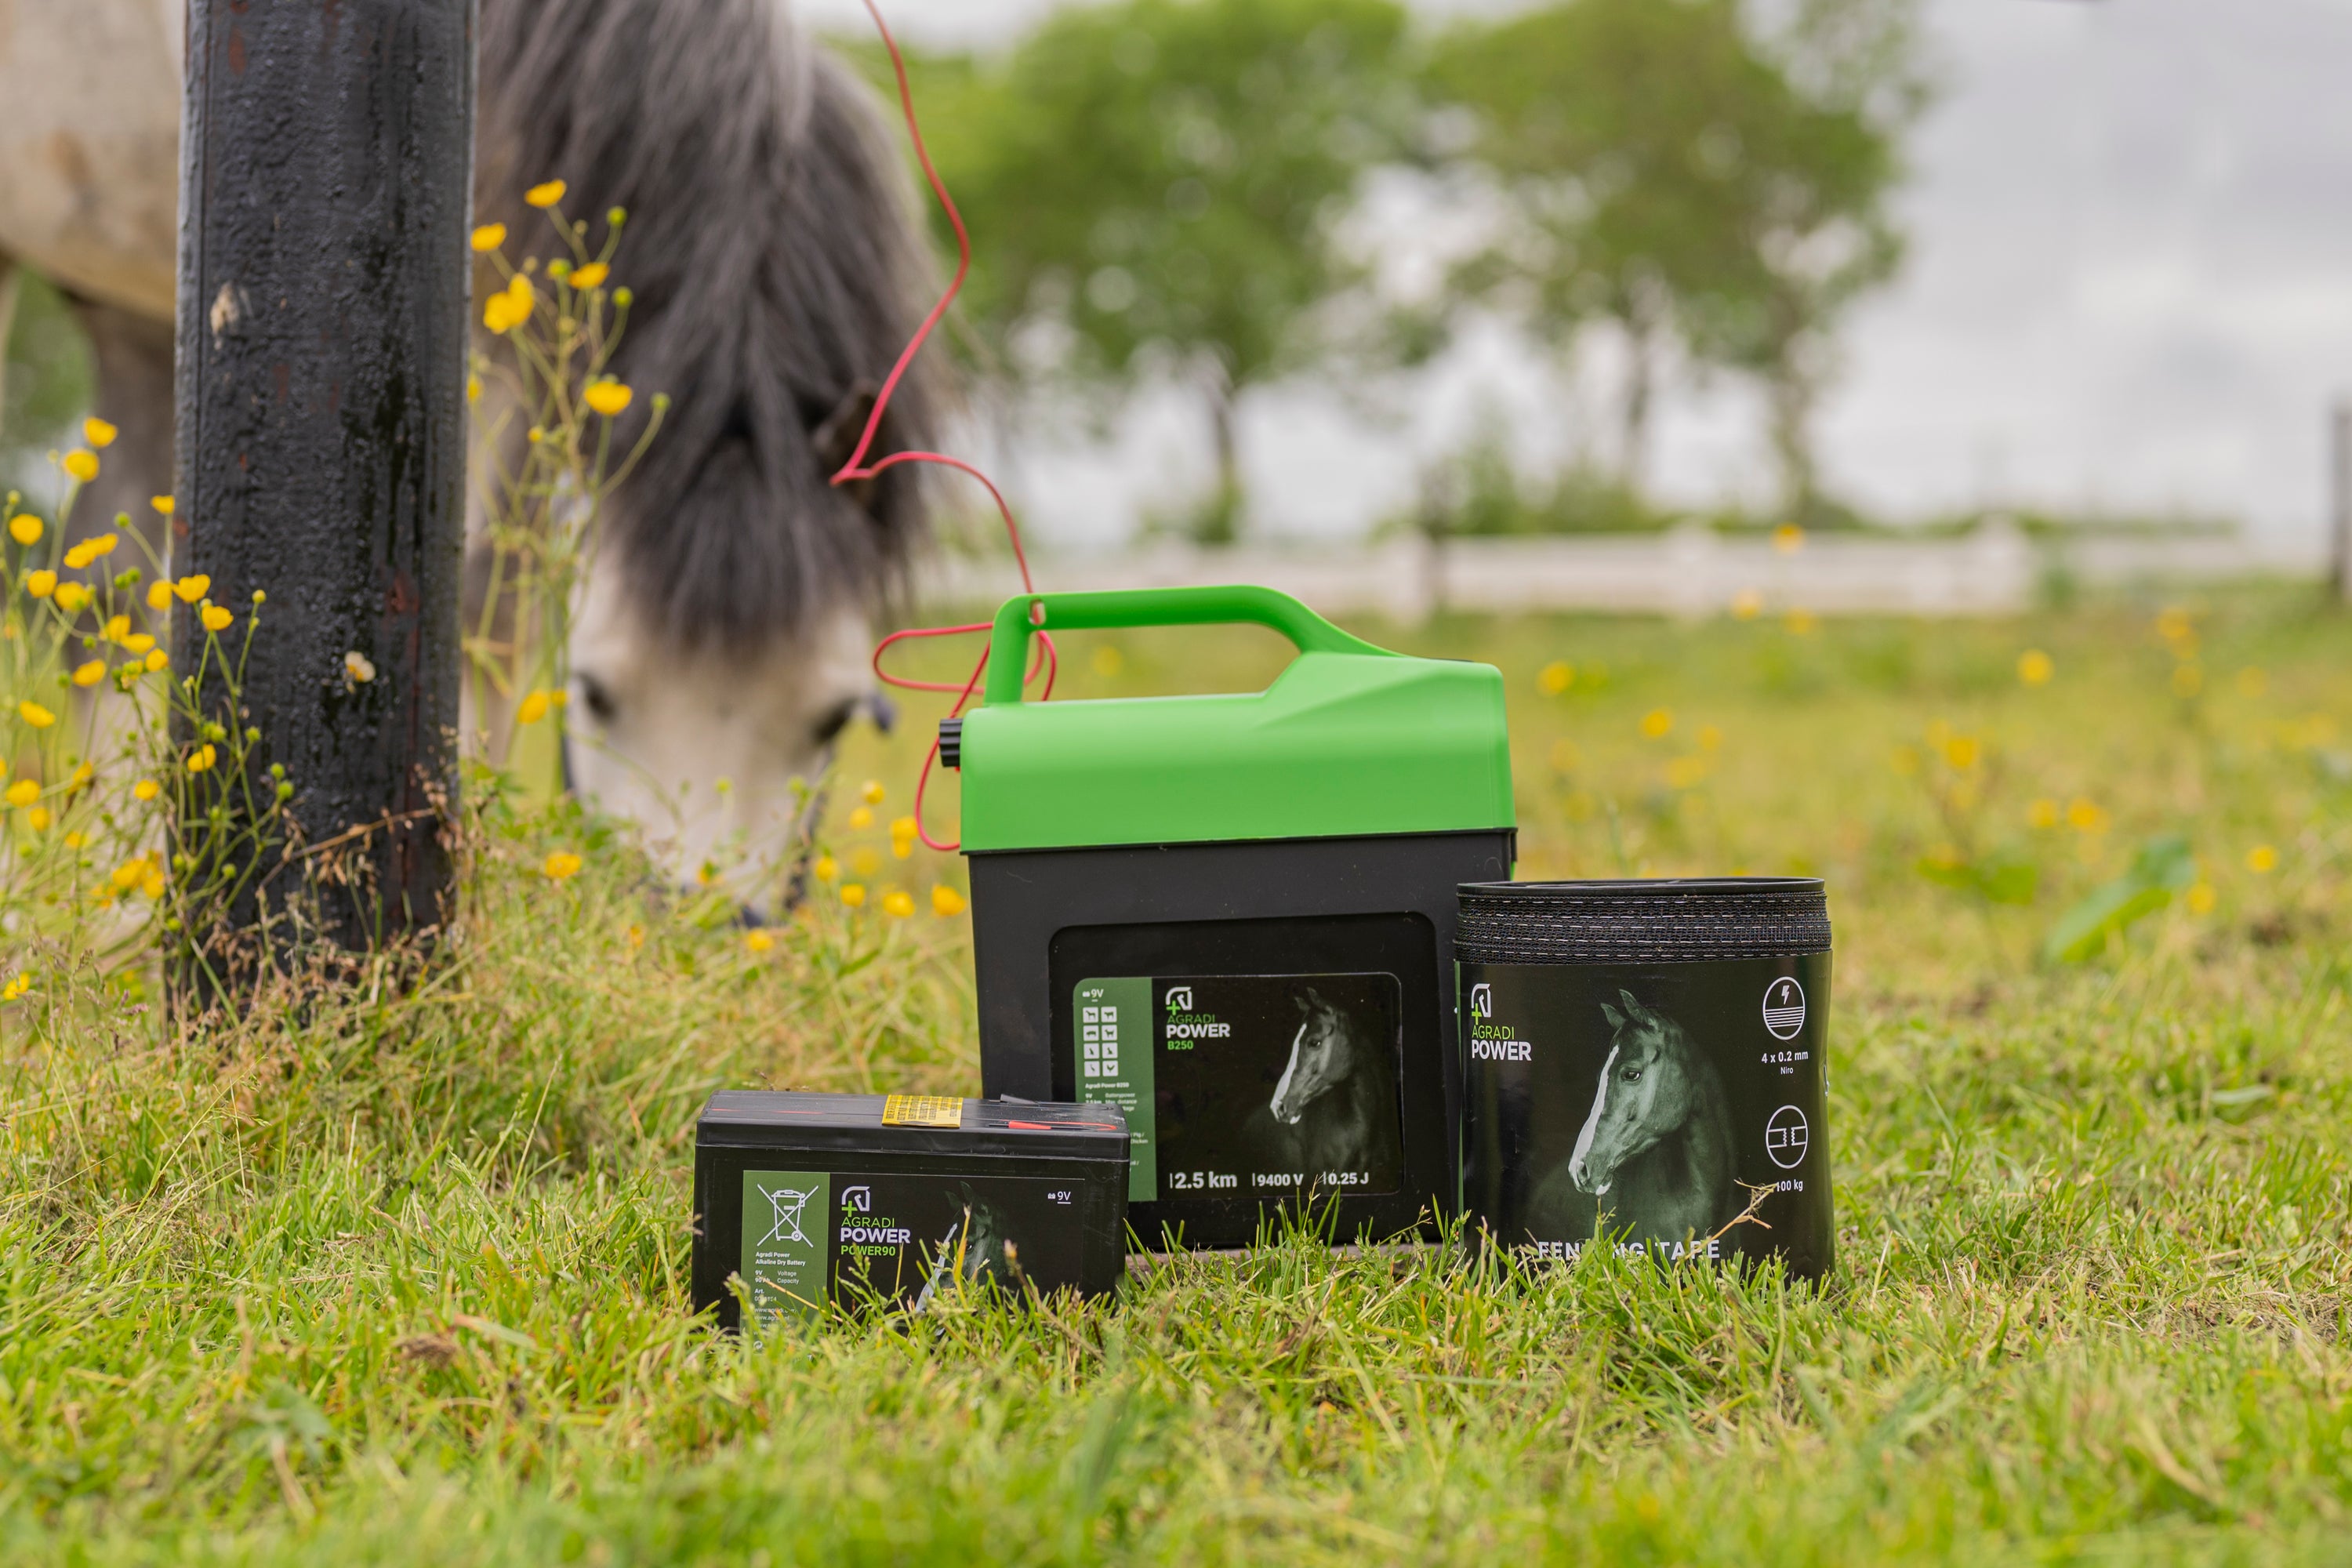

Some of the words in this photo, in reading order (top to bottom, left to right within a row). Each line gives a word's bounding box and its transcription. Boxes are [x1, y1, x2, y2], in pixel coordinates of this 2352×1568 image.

[1091, 988, 1105, 998] 9V
[1167, 1014, 1215, 1024] AGRADI
[1166, 1023, 1231, 1039] POWER
[1472, 1025, 1515, 1040] AGRADI
[1167, 1040, 1193, 1051] B250
[1471, 1040, 1532, 1062] POWER
[1761, 1052, 1768, 1064] 4
[1769, 1054, 1776, 1063] x
[1778, 1051, 1792, 1062] 0.2
[1794, 1051, 1809, 1061] mm
[1780, 1066, 1794, 1075] Niro
[1174, 1171, 1205, 1189] 2.5
[1208, 1171, 1238, 1189] km
[1257, 1174, 1291, 1187] 9400
[1293, 1173, 1305, 1186] V
[1327, 1171, 1358, 1185] 0.25
[1359, 1171, 1370, 1185] J
[1793, 1178, 1803, 1192] kg
[1057, 1190, 1072, 1201] 9V
[840, 1217, 895, 1228] AGRADI
[840, 1227, 911, 1243] POWER
[840, 1245, 896, 1256] POWER90
[1537, 1241, 1645, 1261] FENNG
